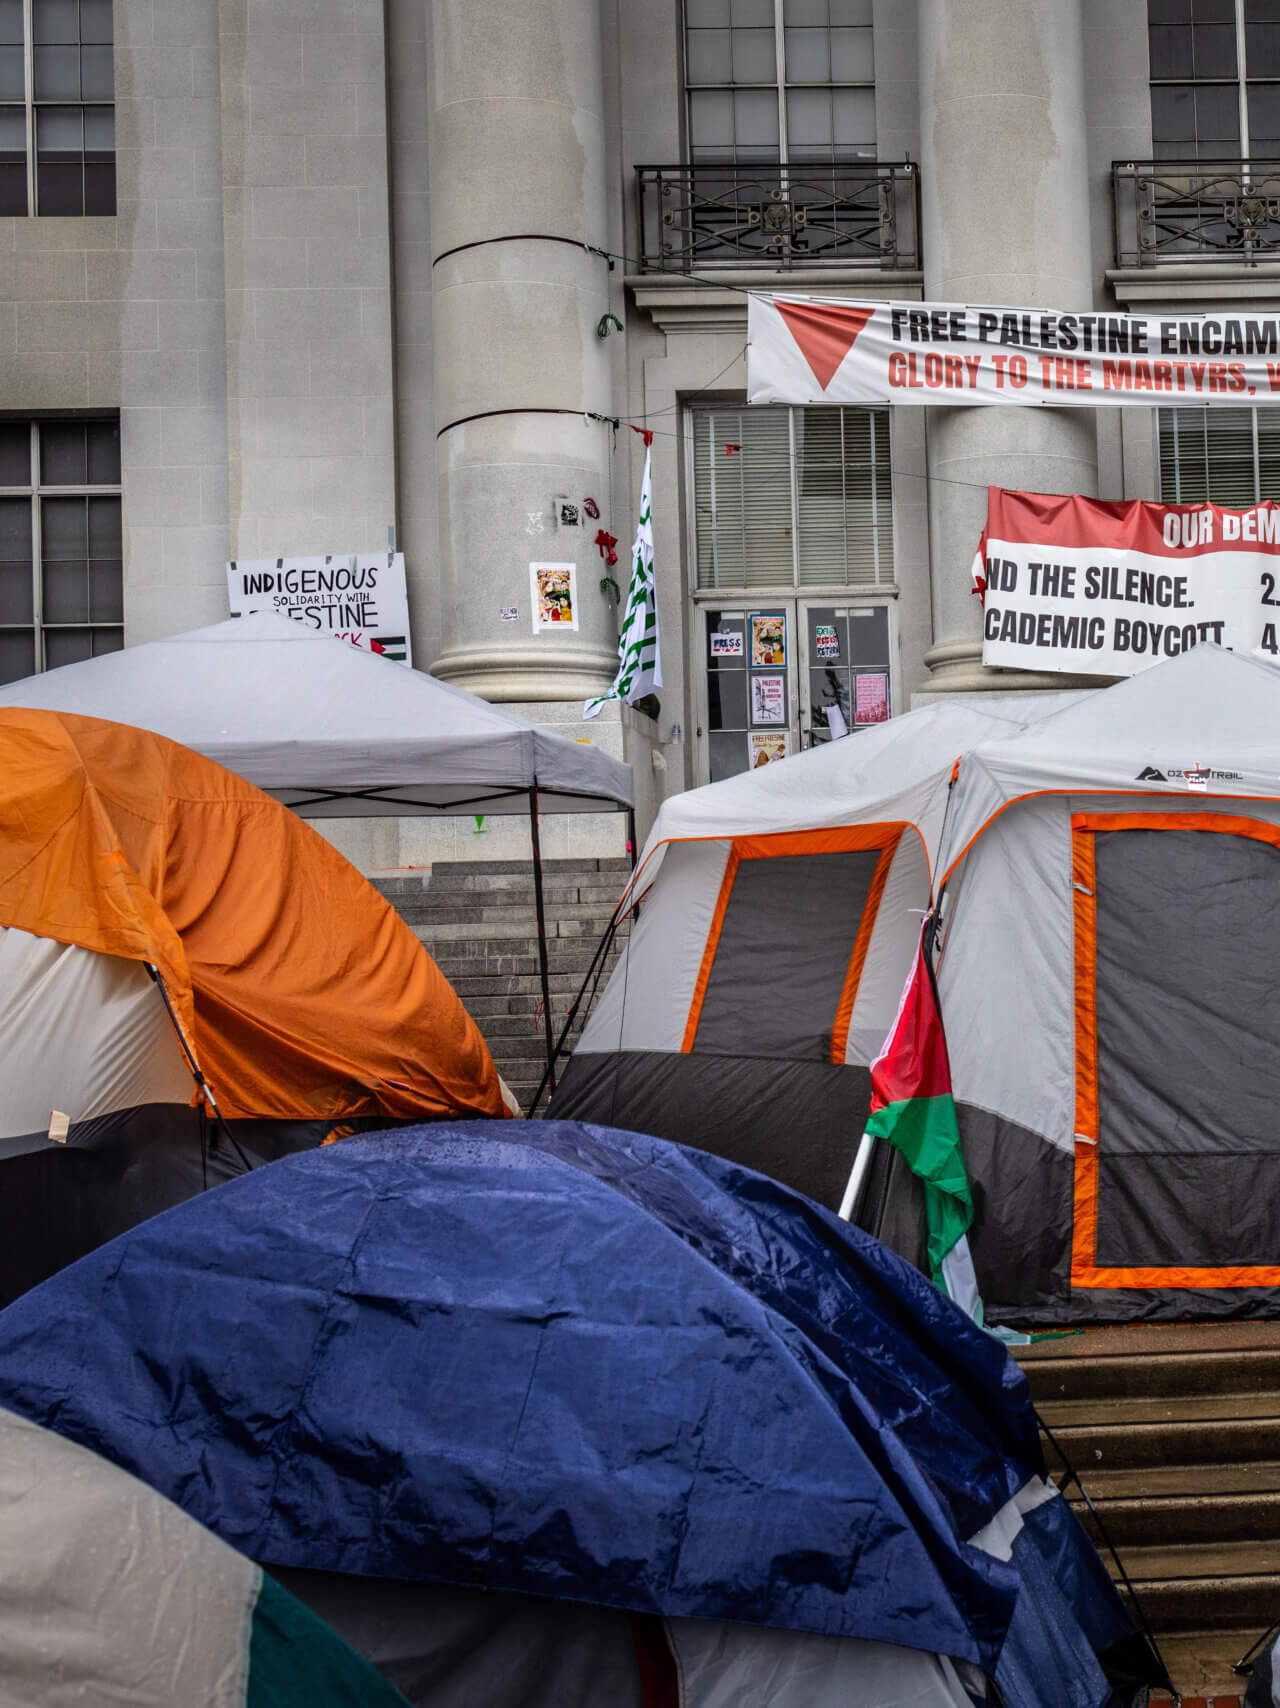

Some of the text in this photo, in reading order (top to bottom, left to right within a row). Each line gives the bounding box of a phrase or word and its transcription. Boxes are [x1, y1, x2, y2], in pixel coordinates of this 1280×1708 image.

[891, 308, 968, 342] FREE
[979, 312, 1150, 354] PALESTINE
[888, 352, 979, 389] GLORY
[996, 354, 1028, 389] TO
[1041, 356, 1094, 390] THE
[1102, 359, 1256, 396] MARTYRS,
[1163, 508, 1214, 548] OUR
[243, 568, 378, 595] INDIGENOUS
[273, 592, 370, 607] SOLIDARITY WITH
[1028, 563, 1076, 599] THE
[1084, 566, 1194, 608] SILENCE.
